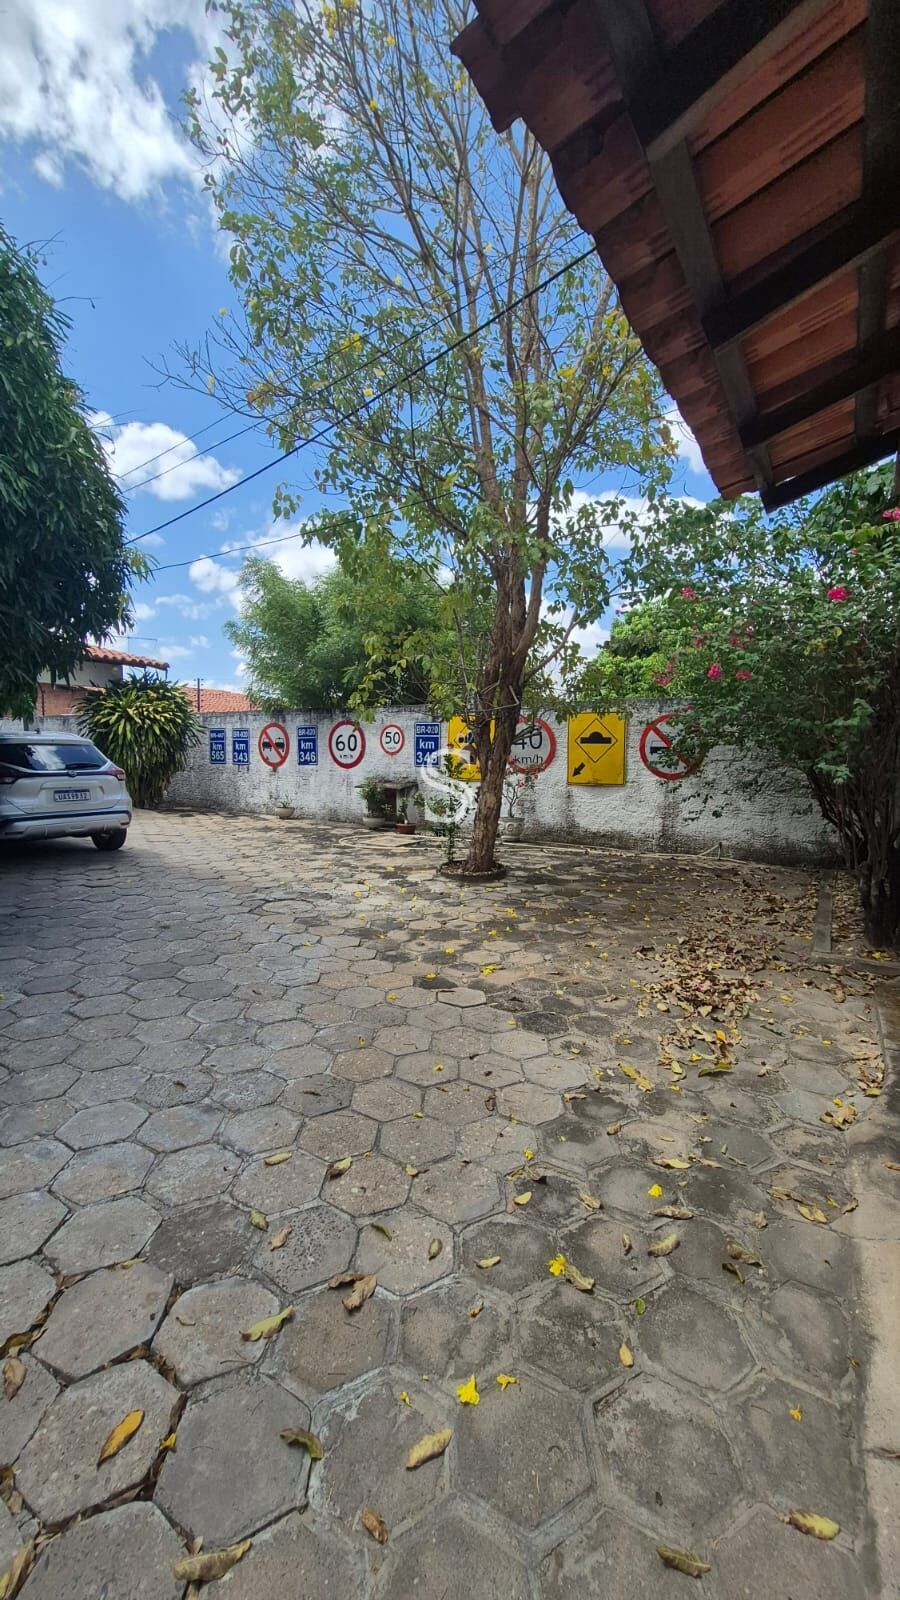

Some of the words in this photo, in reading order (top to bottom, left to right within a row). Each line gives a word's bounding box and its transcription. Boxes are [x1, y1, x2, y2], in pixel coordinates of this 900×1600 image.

[335, 734, 357, 751] 60
[385, 731, 401, 744] 50
[212, 742, 223, 751] km
[235, 741, 246, 751] km
[300, 740, 314, 750] km
[419, 738, 435, 750] km
[211, 750, 225, 761] 565
[233, 752, 248, 762] 343
[299, 751, 316, 762] 346
